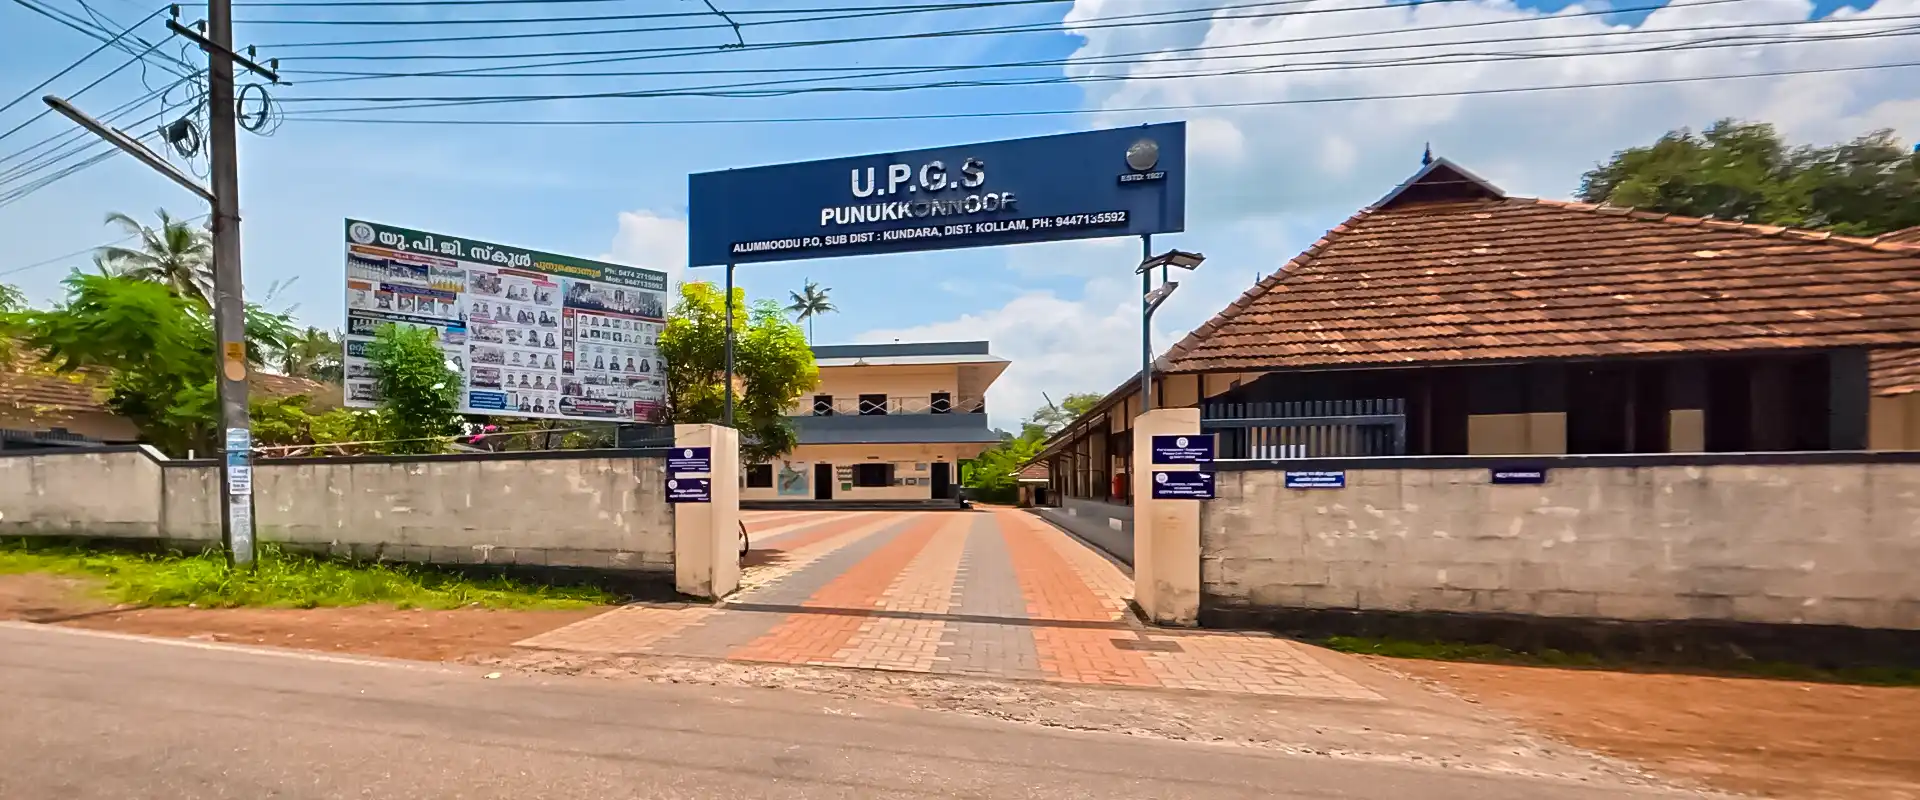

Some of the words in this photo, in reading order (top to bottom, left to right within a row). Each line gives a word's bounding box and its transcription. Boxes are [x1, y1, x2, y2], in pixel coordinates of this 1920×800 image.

[851, 157, 985, 197] U.P.G.S
[733, 238, 801, 253] ALUMMOODU
[824, 234, 848, 246] SUB
[883, 226, 942, 241] KUNDARA,
[944, 223, 973, 236] DIST:
[975, 219, 1029, 233] KOLLAM,
[1032, 217, 1052, 229] PH:
[1055, 211, 1126, 227] 9447135592
